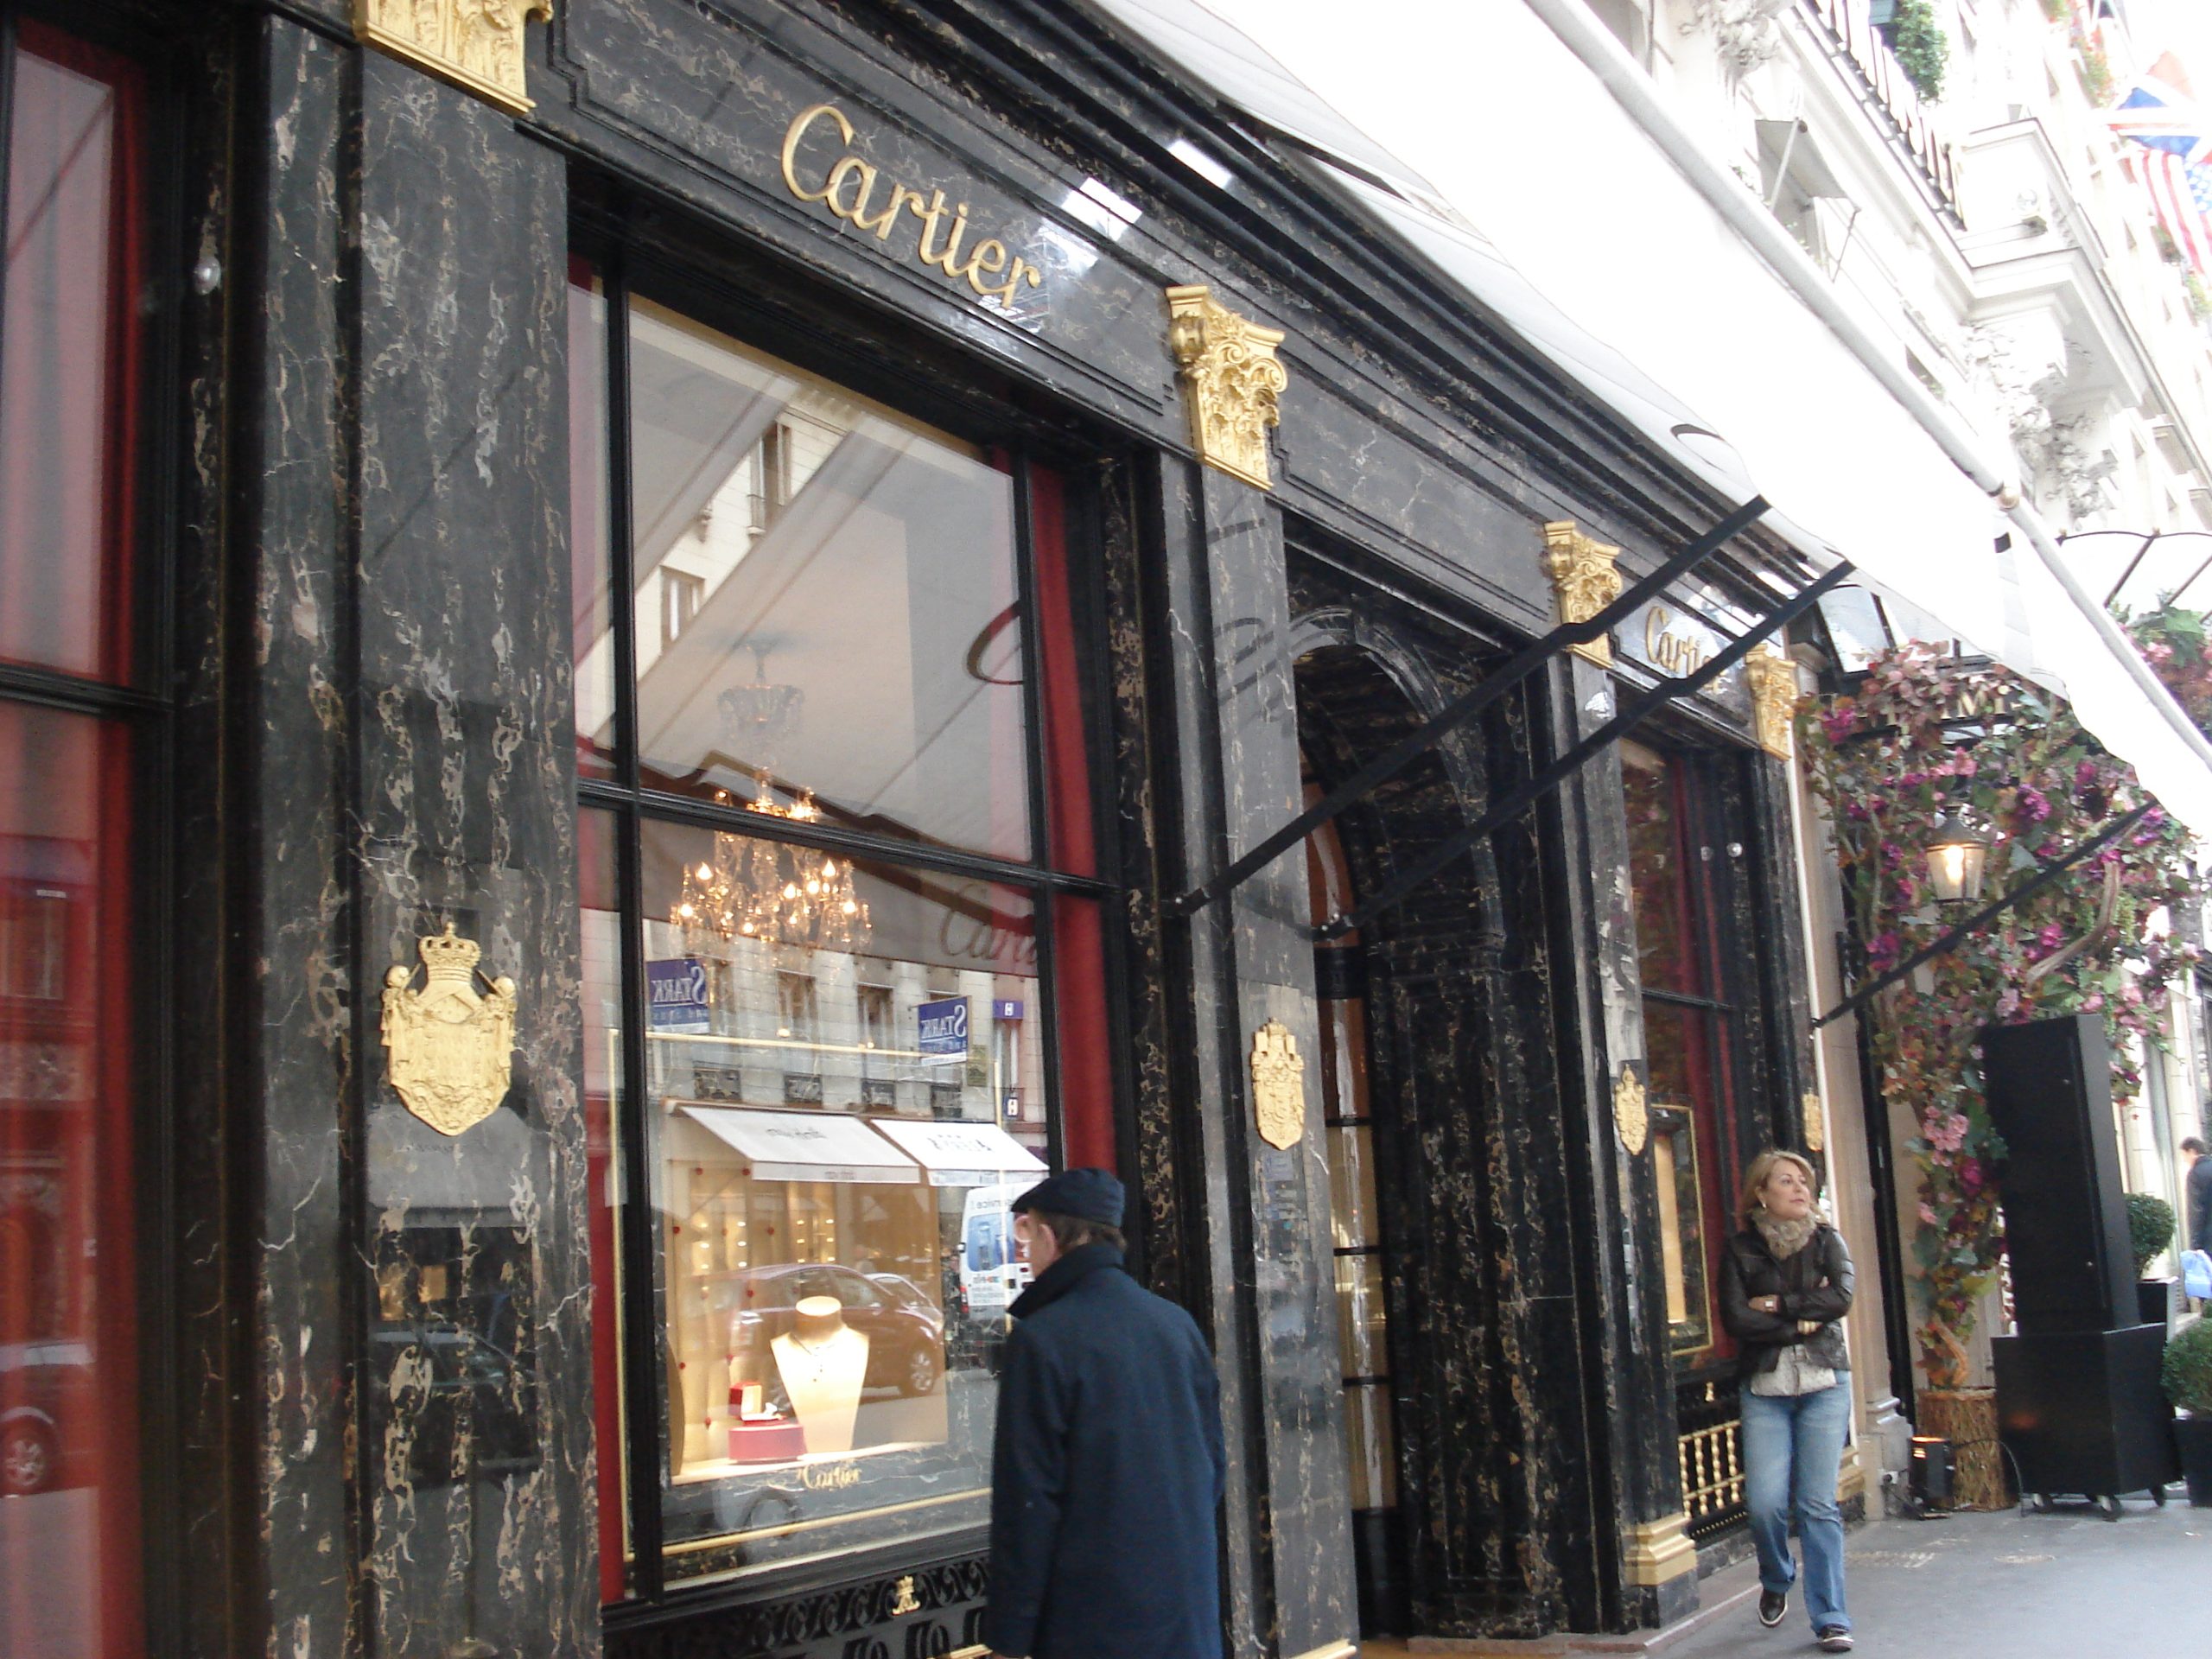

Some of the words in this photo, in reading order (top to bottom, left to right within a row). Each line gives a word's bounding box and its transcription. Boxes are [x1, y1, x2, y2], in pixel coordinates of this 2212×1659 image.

[781, 104, 1041, 309] Cartier
[1645, 606, 1732, 695] Cartir
[803, 1463, 861, 1490] Cartier
